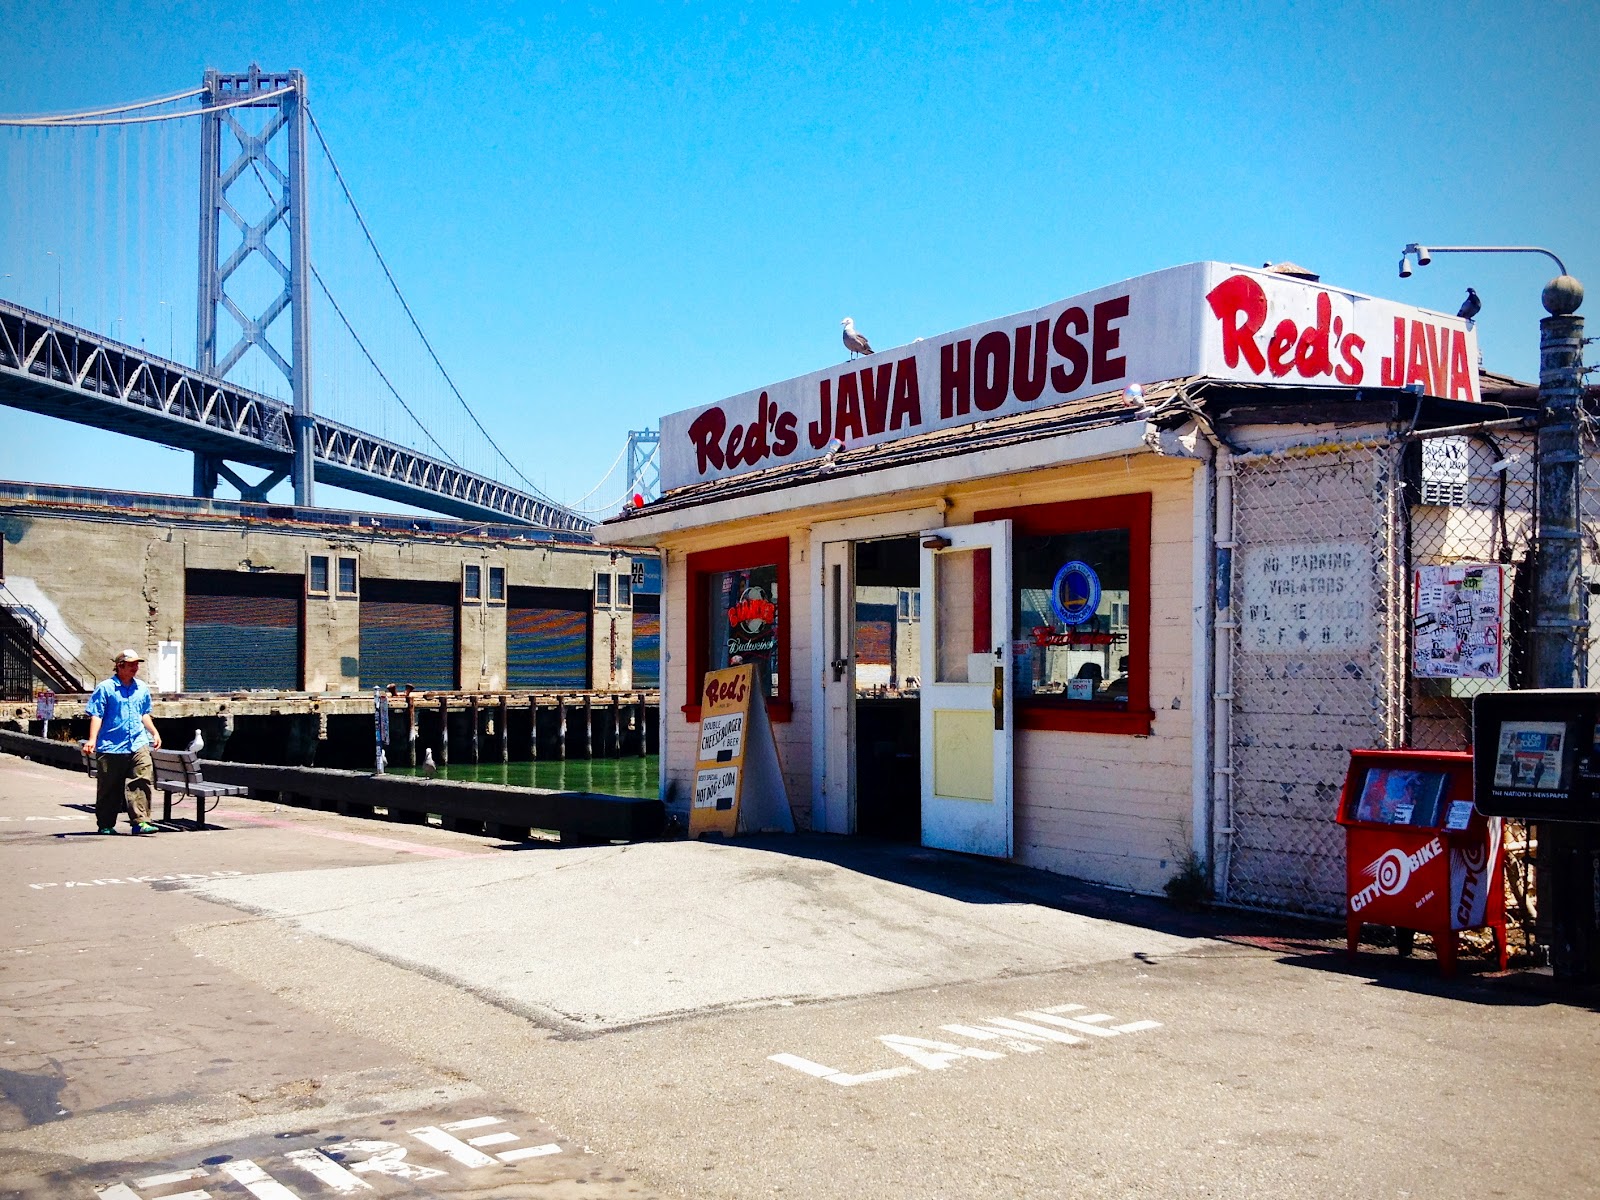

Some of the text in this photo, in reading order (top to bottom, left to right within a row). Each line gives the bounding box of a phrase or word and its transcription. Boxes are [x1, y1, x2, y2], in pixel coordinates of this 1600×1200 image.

[1206, 274, 1473, 402] Red's JAVA
[688, 295, 1130, 475] Red's JAVA HOUSE
[1263, 552, 1351, 573] NO PARKING
[1270, 577, 1344, 595] VIOLATORS
[727, 638, 774, 654] Budweiser
[706, 674, 746, 707] Red's
[702, 718, 742, 750] CHEESEBURGER
[704, 721, 721, 731] DOUBLE
[726, 738, 739, 747] BEER
[696, 788, 706, 802] HOT
[706, 781, 717, 800] DOG
[722, 772, 735, 788] SODA
[1504, 790, 1532, 798] NATION'S
[1351, 880, 1380, 912] CITY
[1410, 837, 1443, 873] BIKE
[767, 1004, 1163, 1085] LANE
